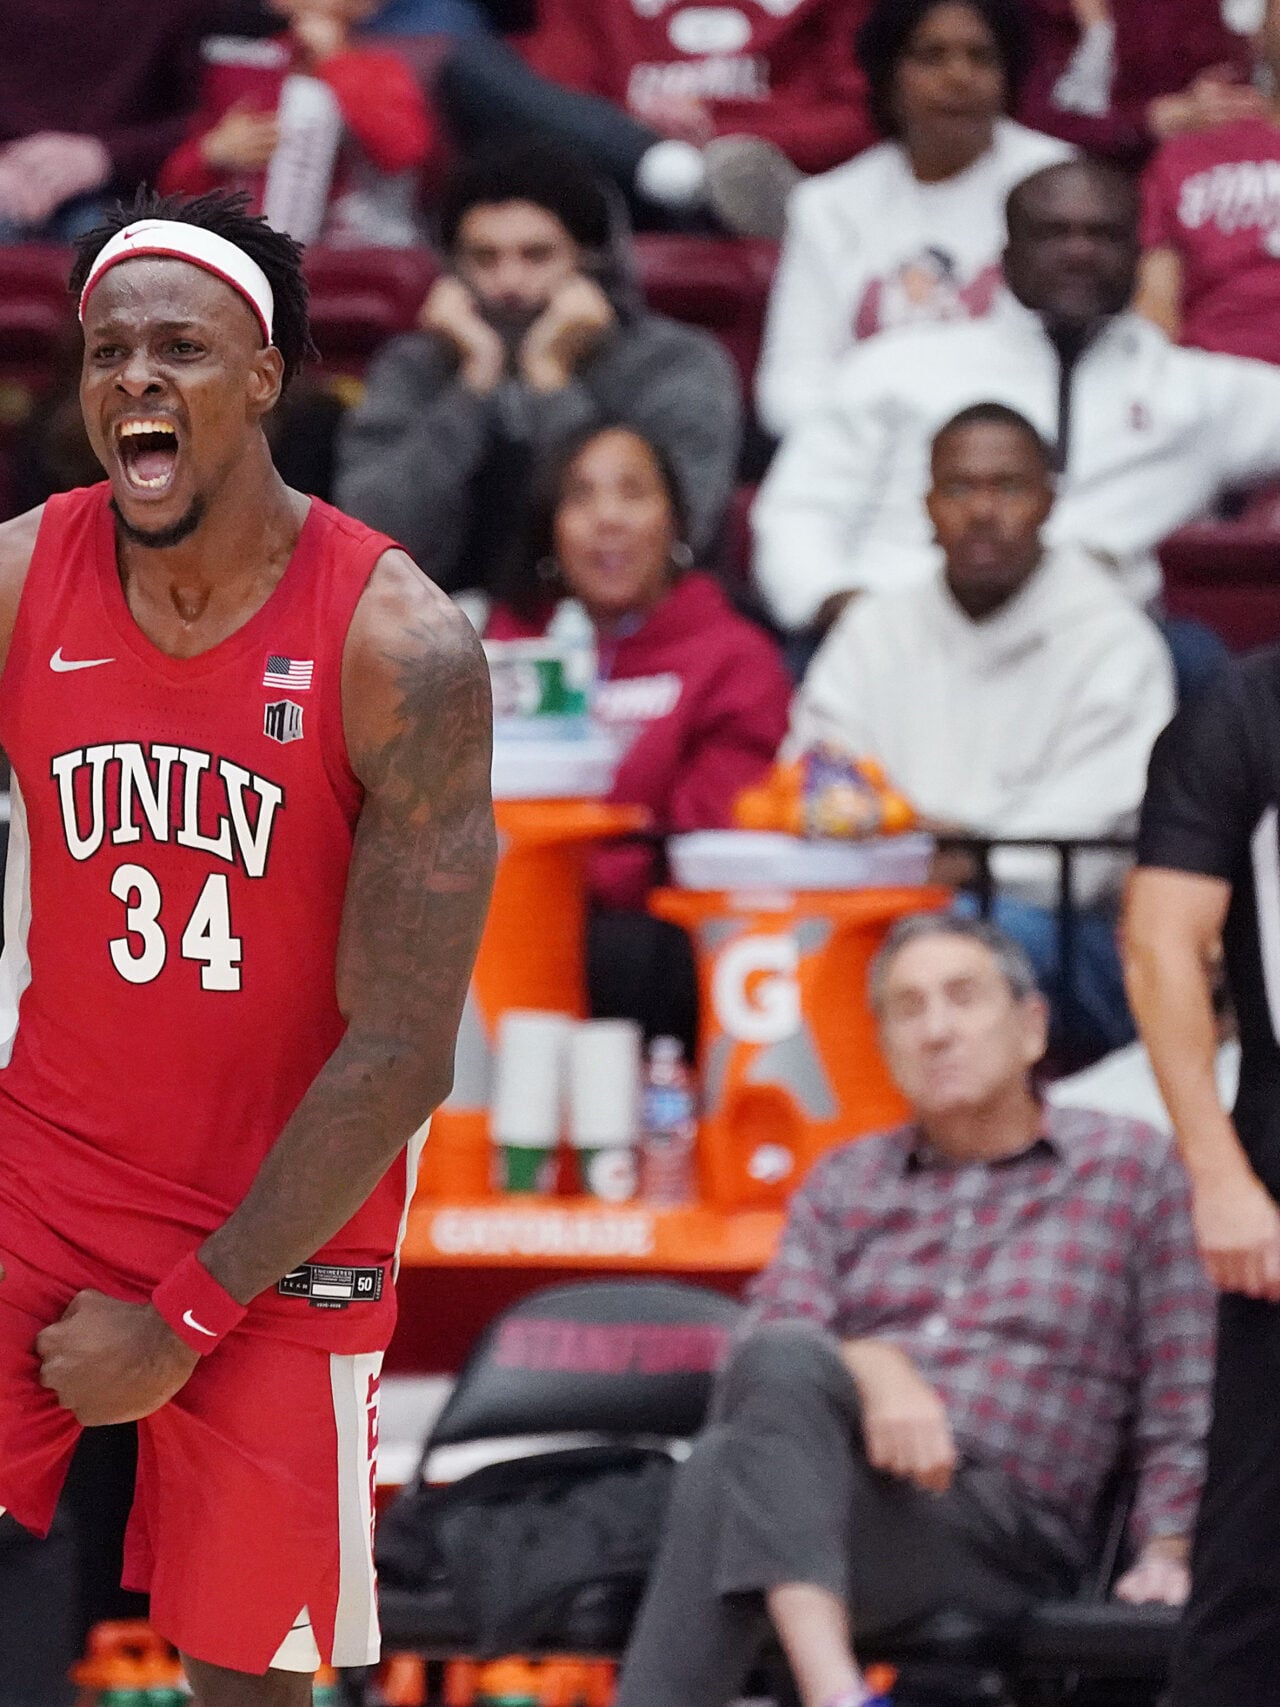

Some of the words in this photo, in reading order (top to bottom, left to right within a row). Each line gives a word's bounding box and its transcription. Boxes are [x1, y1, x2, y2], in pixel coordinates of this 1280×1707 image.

[51, 742, 285, 878] UNLV
[109, 862, 243, 991] 34
[711, 934, 801, 1043] G
[283, 1281, 308, 1290] TEAM
[357, 1277, 373, 1291] 50
